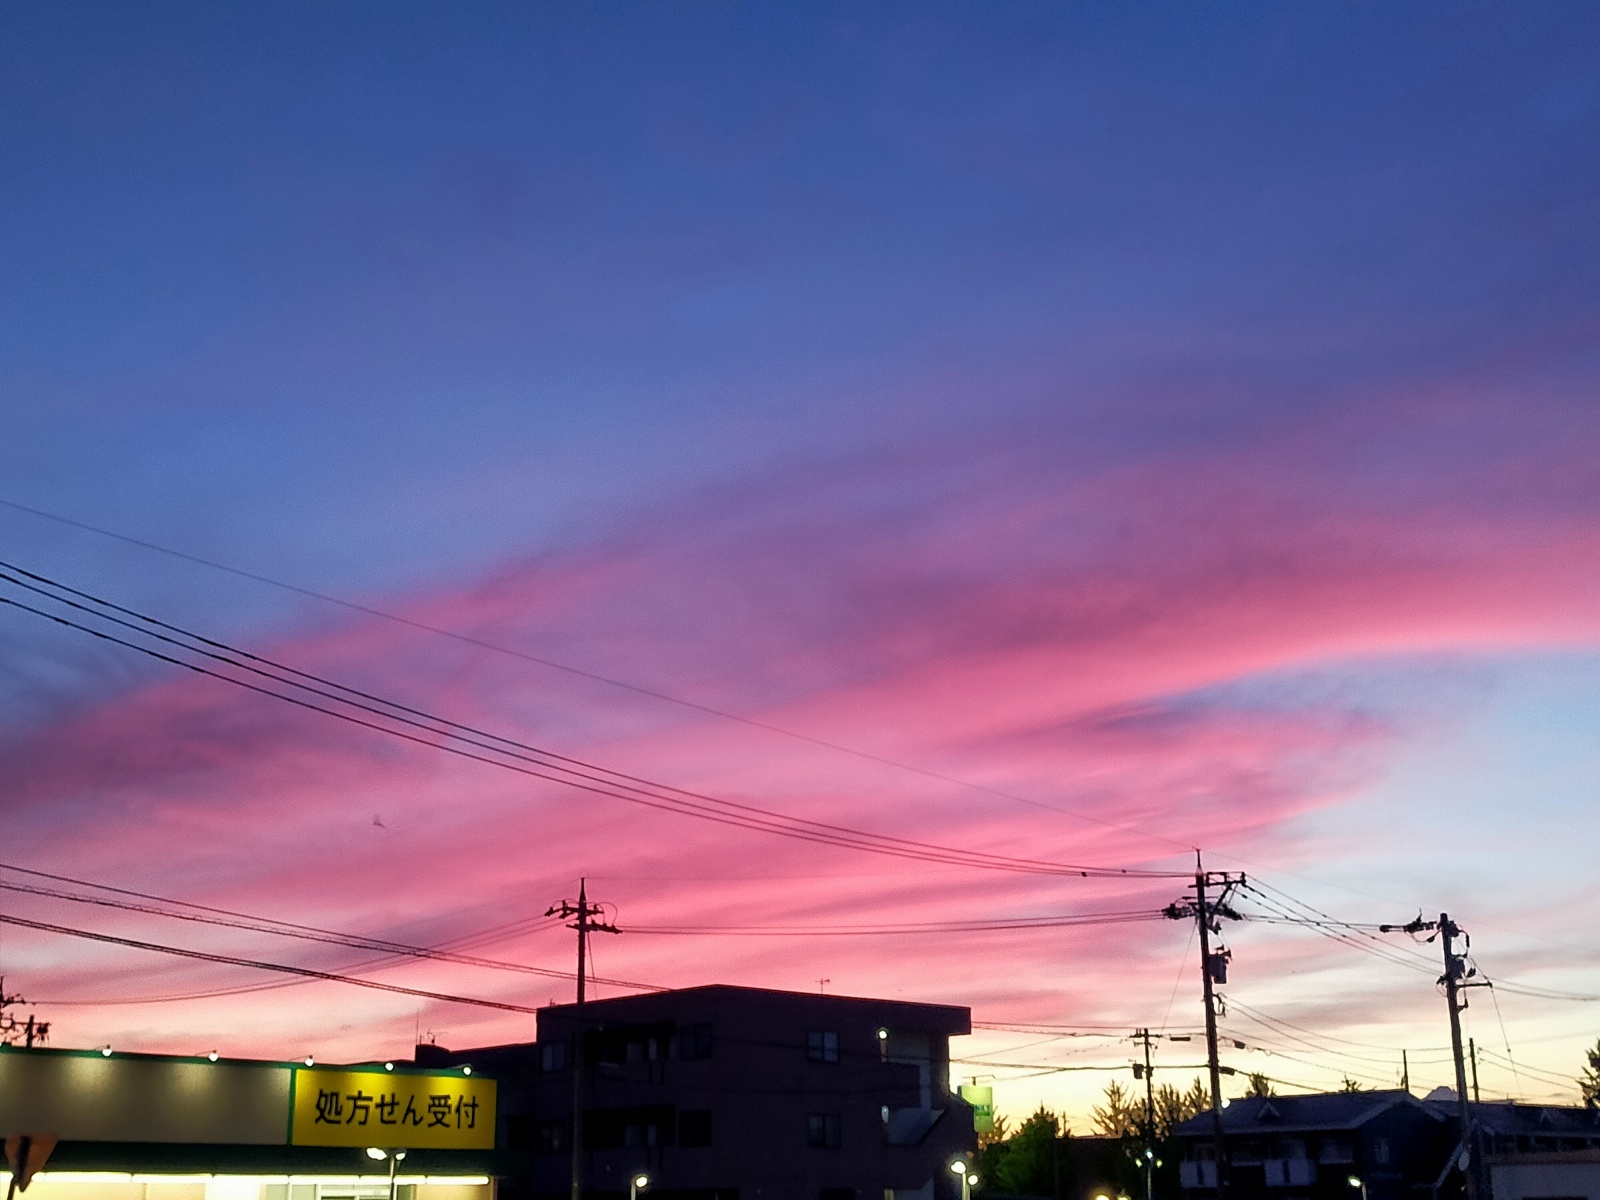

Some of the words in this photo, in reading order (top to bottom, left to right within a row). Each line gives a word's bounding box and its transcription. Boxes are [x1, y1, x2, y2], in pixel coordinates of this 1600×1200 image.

[314, 1089, 479, 1129] 処方せん受付
